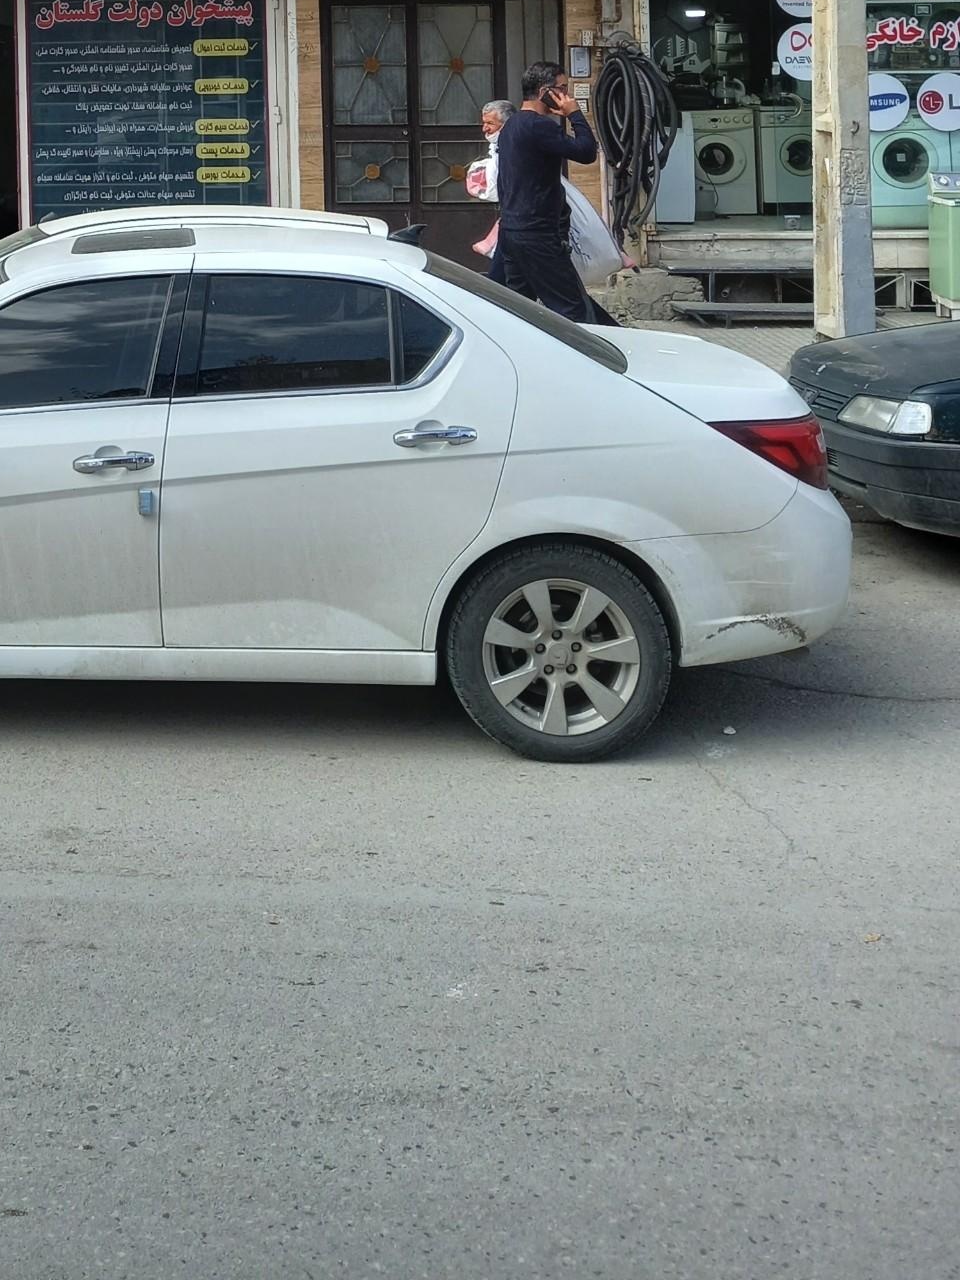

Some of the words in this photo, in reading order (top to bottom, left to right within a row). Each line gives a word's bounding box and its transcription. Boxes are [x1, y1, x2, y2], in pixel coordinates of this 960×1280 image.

[213, 41, 226, 53] ثبت
[226, 42, 247, 52] خدمات
[222, 82, 245, 91] خدمات
[869, 98, 901, 107] MSUNG
[198, 122, 214, 131] کارت
[200, 147, 218, 158] پست
[220, 145, 246, 155] خدمات
[201, 171, 219, 181] بورس
[221, 170, 246, 179] خدمات
